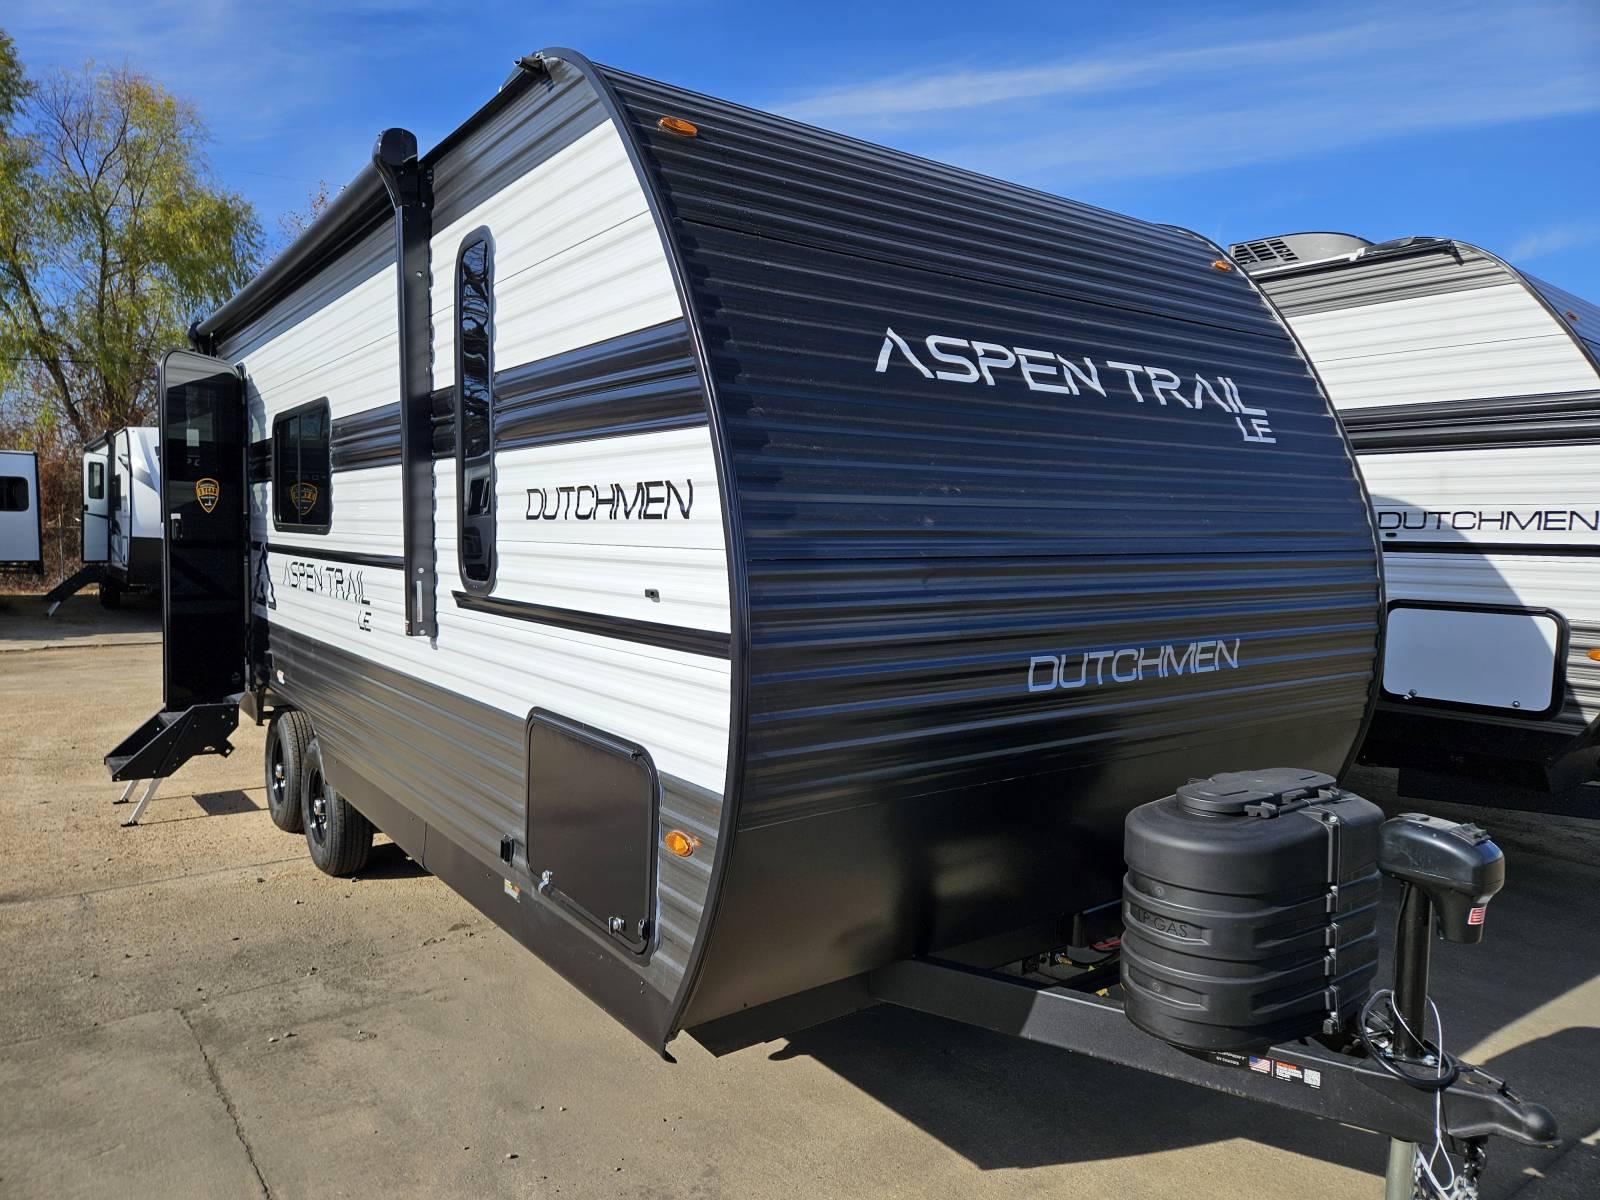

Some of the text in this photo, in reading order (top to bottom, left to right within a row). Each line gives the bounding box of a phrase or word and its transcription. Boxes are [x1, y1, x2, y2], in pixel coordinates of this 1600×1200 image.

[876, 327, 1267, 416] ASPEN TRAIL
[1237, 417, 1276, 443] LE
[526, 479, 693, 520] DUTCHMEN
[1378, 510, 1600, 531] DUTCHMEN
[283, 560, 370, 605] ASPEN TRAIL
[358, 610, 371, 632] LE
[1028, 638, 1240, 692] DUTCHMEN
[1154, 918, 1187, 938] GAS
